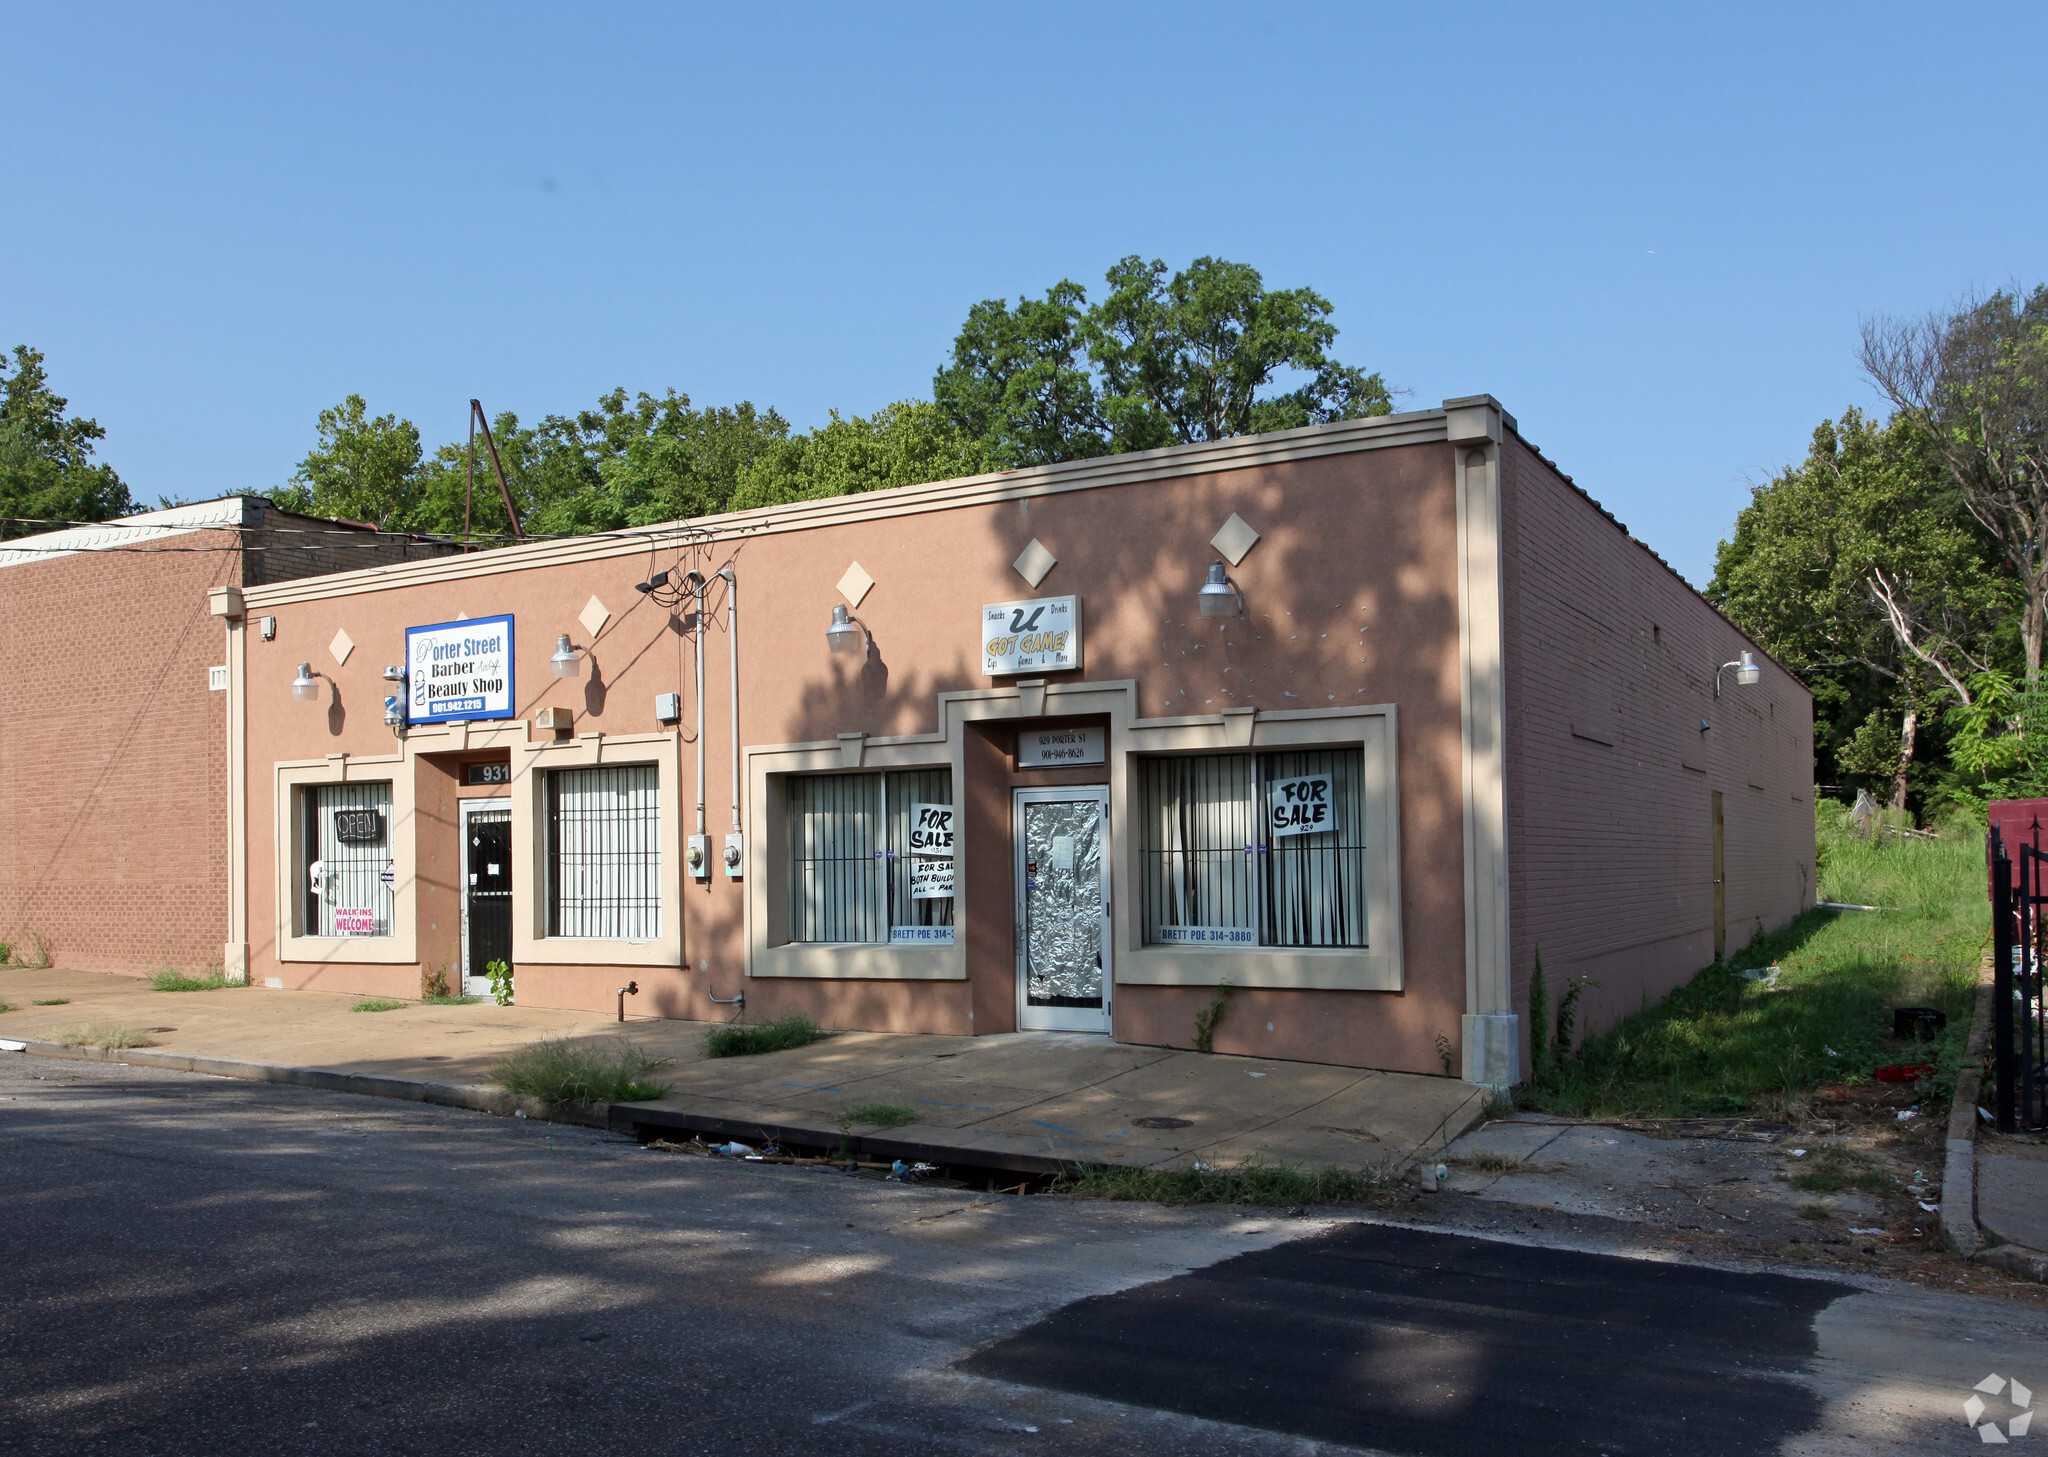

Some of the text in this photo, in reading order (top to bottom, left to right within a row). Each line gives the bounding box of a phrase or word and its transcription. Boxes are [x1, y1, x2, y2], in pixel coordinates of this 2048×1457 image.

[1050, 603, 1068, 614] Drinks
[988, 610, 1005, 621] Snacks
[1009, 606, 1046, 634] U
[416, 635, 501, 663] Porter Street
[986, 630, 1069, 657] GOT GAME!
[1055, 652, 1068, 663] More
[432, 661, 475, 678] Barber
[428, 678, 503, 698] Beauty Shop
[432, 698, 482, 713] 901.942.1215
[1039, 733, 1087, 745] 929 PORTER ST
[1041, 747, 1085, 760] 901-946-8626
[482, 764, 510, 782] 931
[1281, 779, 1328, 803] FOR
[918, 808, 953, 831] FOR
[1273, 803, 1328, 829] SALE
[337, 812, 377, 835] OPEN
[1300, 824, 1314, 833] 929
[910, 830, 954, 849] SALE
[917, 863, 935, 873] FOR
[911, 874, 930, 885] BOTH
[913, 886, 926, 894] ALL
[335, 908, 373, 916] WALK-INS
[336, 918, 373, 931] WELCOME
[892, 929, 915, 939] BRETT
[917, 929, 931, 939] POE
[1162, 929, 1252, 942] BRETT POE 314-3880
